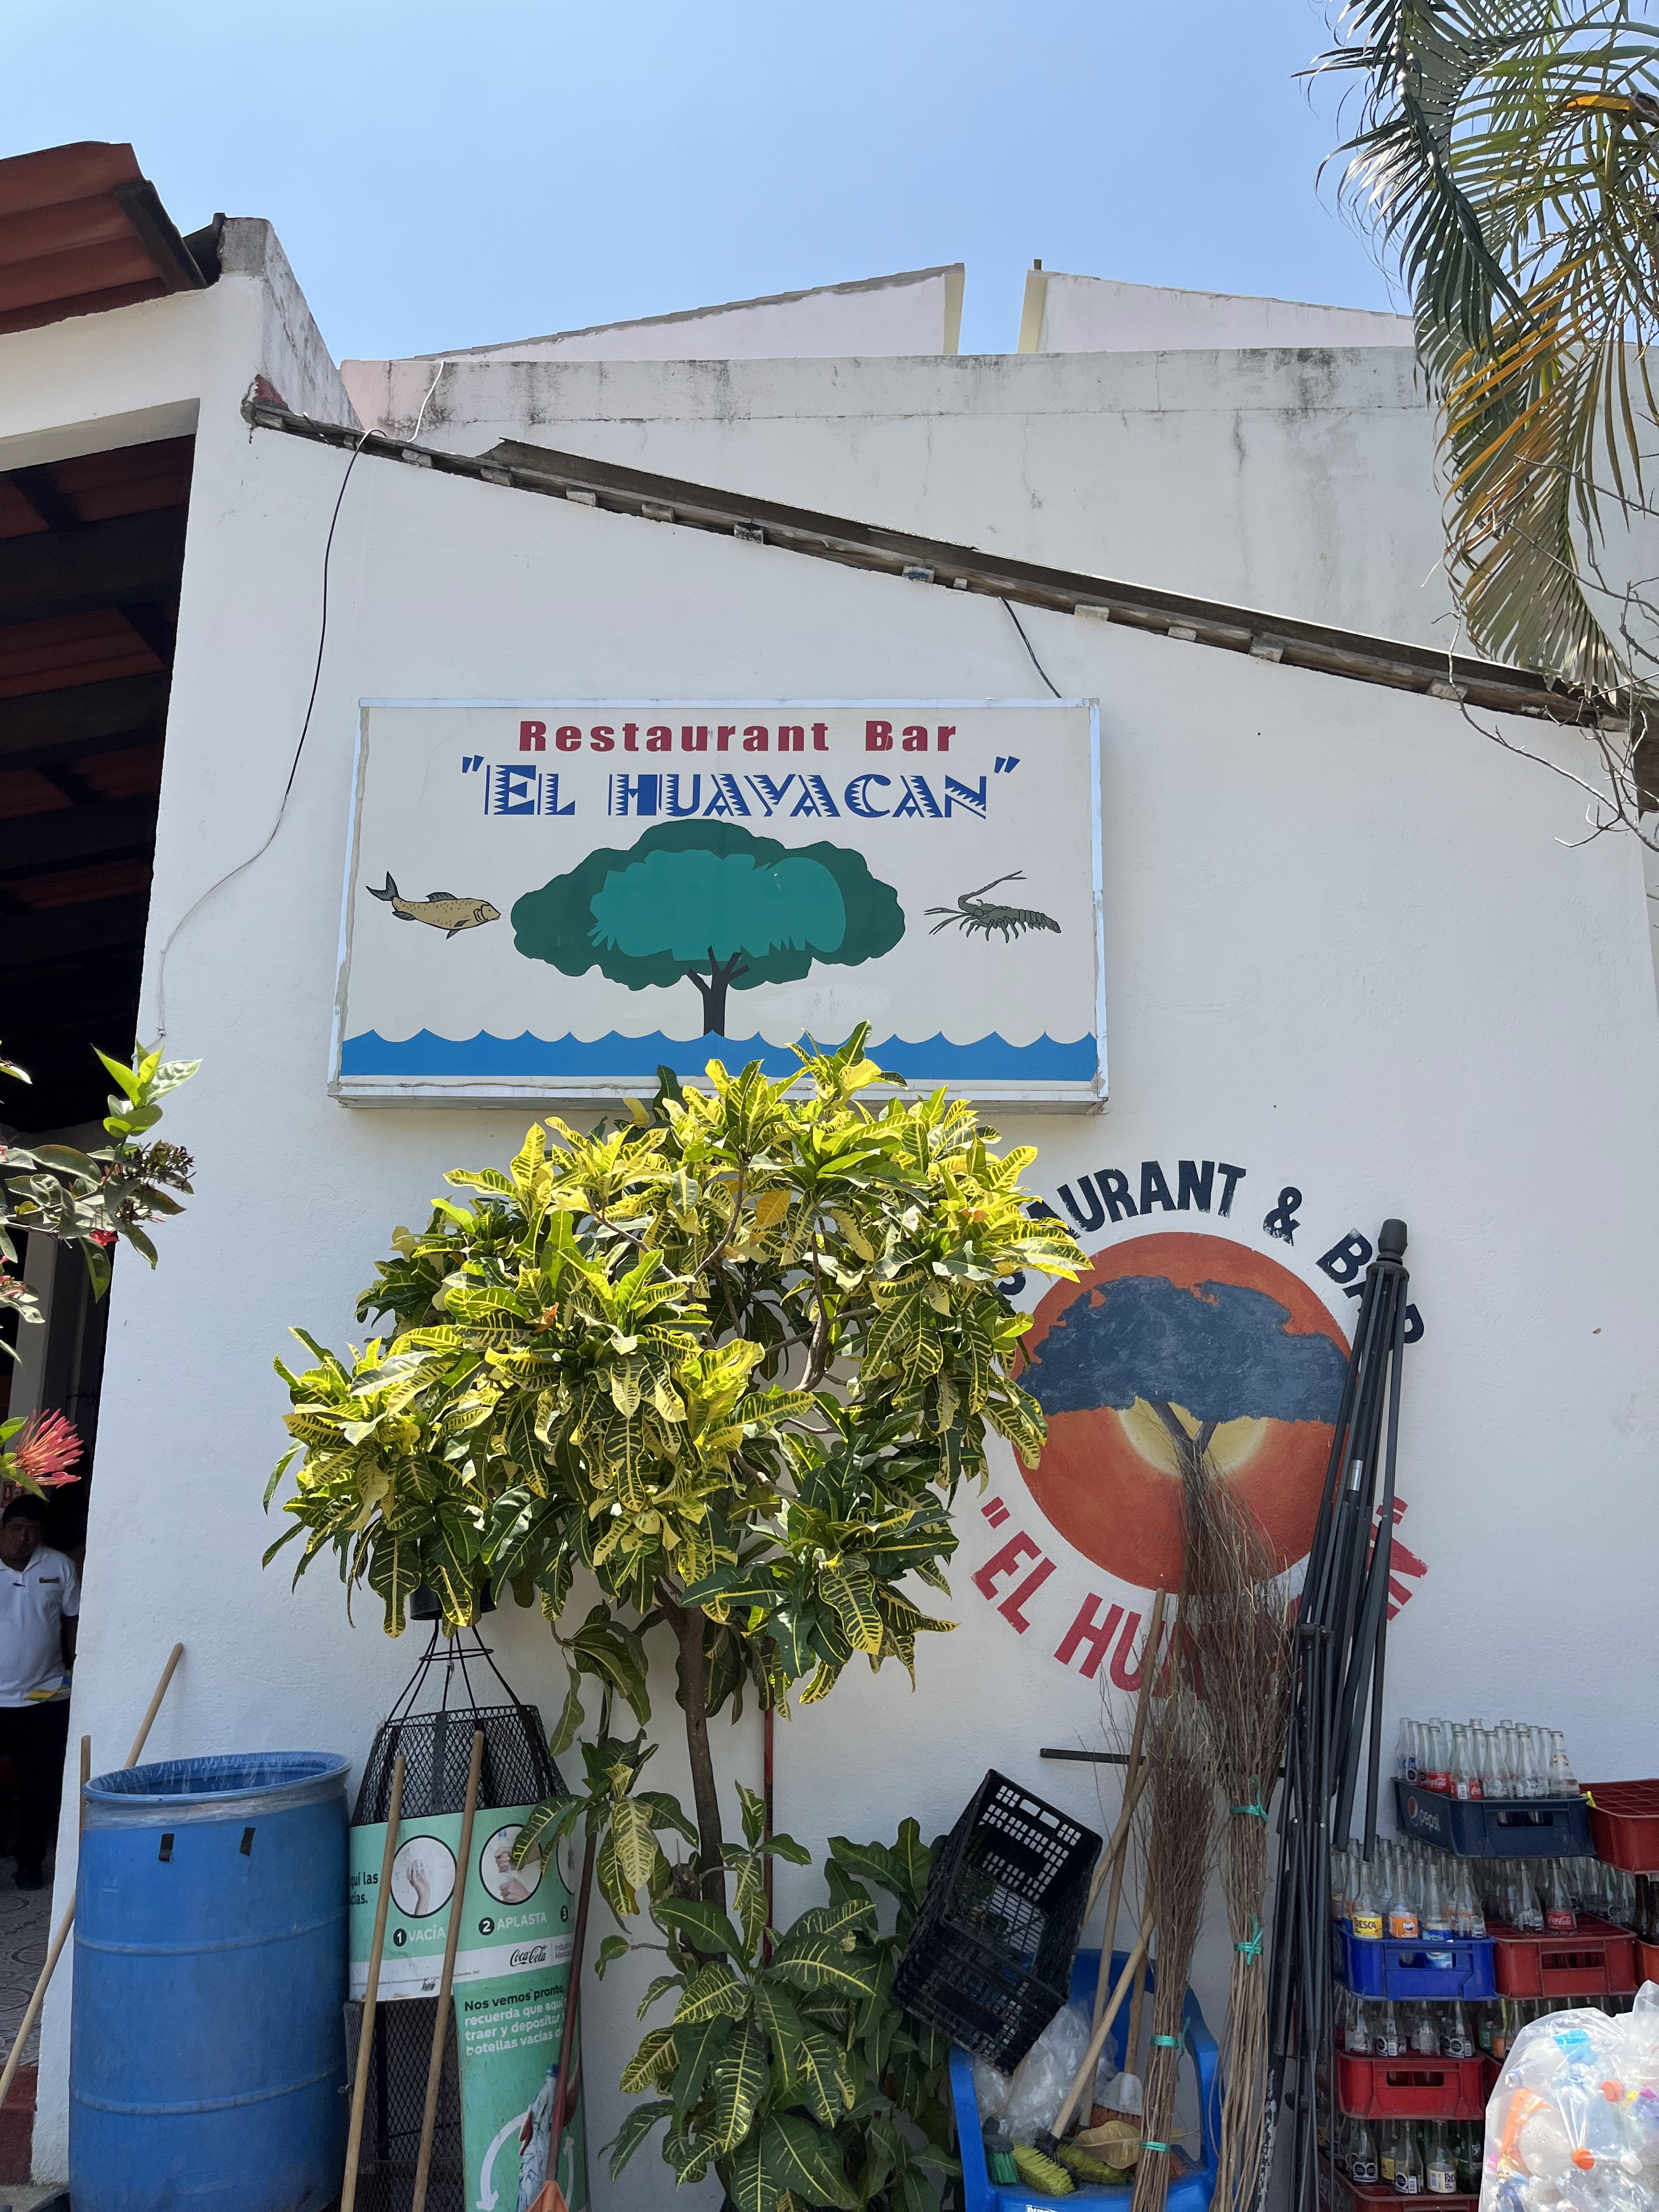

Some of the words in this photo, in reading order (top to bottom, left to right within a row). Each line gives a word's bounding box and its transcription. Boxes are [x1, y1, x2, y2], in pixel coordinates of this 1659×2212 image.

[518, 720, 830, 752] Restaurant
[865, 720, 956, 752] Bar
[461, 754, 576, 816] "EL
[607, 755, 1021, 820] HUAYACAN"
[1262, 1186, 1304, 1246] &
[363, 1872, 379, 1886] las
[349, 1892, 368, 1906] cías.
[408, 1925, 447, 1943] VACÍA
[496, 1911, 548, 1931] APLASTA
[464, 2000, 489, 2012] Nos
[492, 1993, 532, 2007] vemos
[465, 2007, 521, 2027] recuerda
[523, 2004, 543, 2018] que
[545, 1996, 564, 2012] aquí
[465, 2028, 498, 2041] traer
[500, 2025, 509, 2038] y
[511, 2013, 561, 2033] depositar
[466, 2039, 518, 2057] botellas
[520, 2029, 554, 2046] vacías
